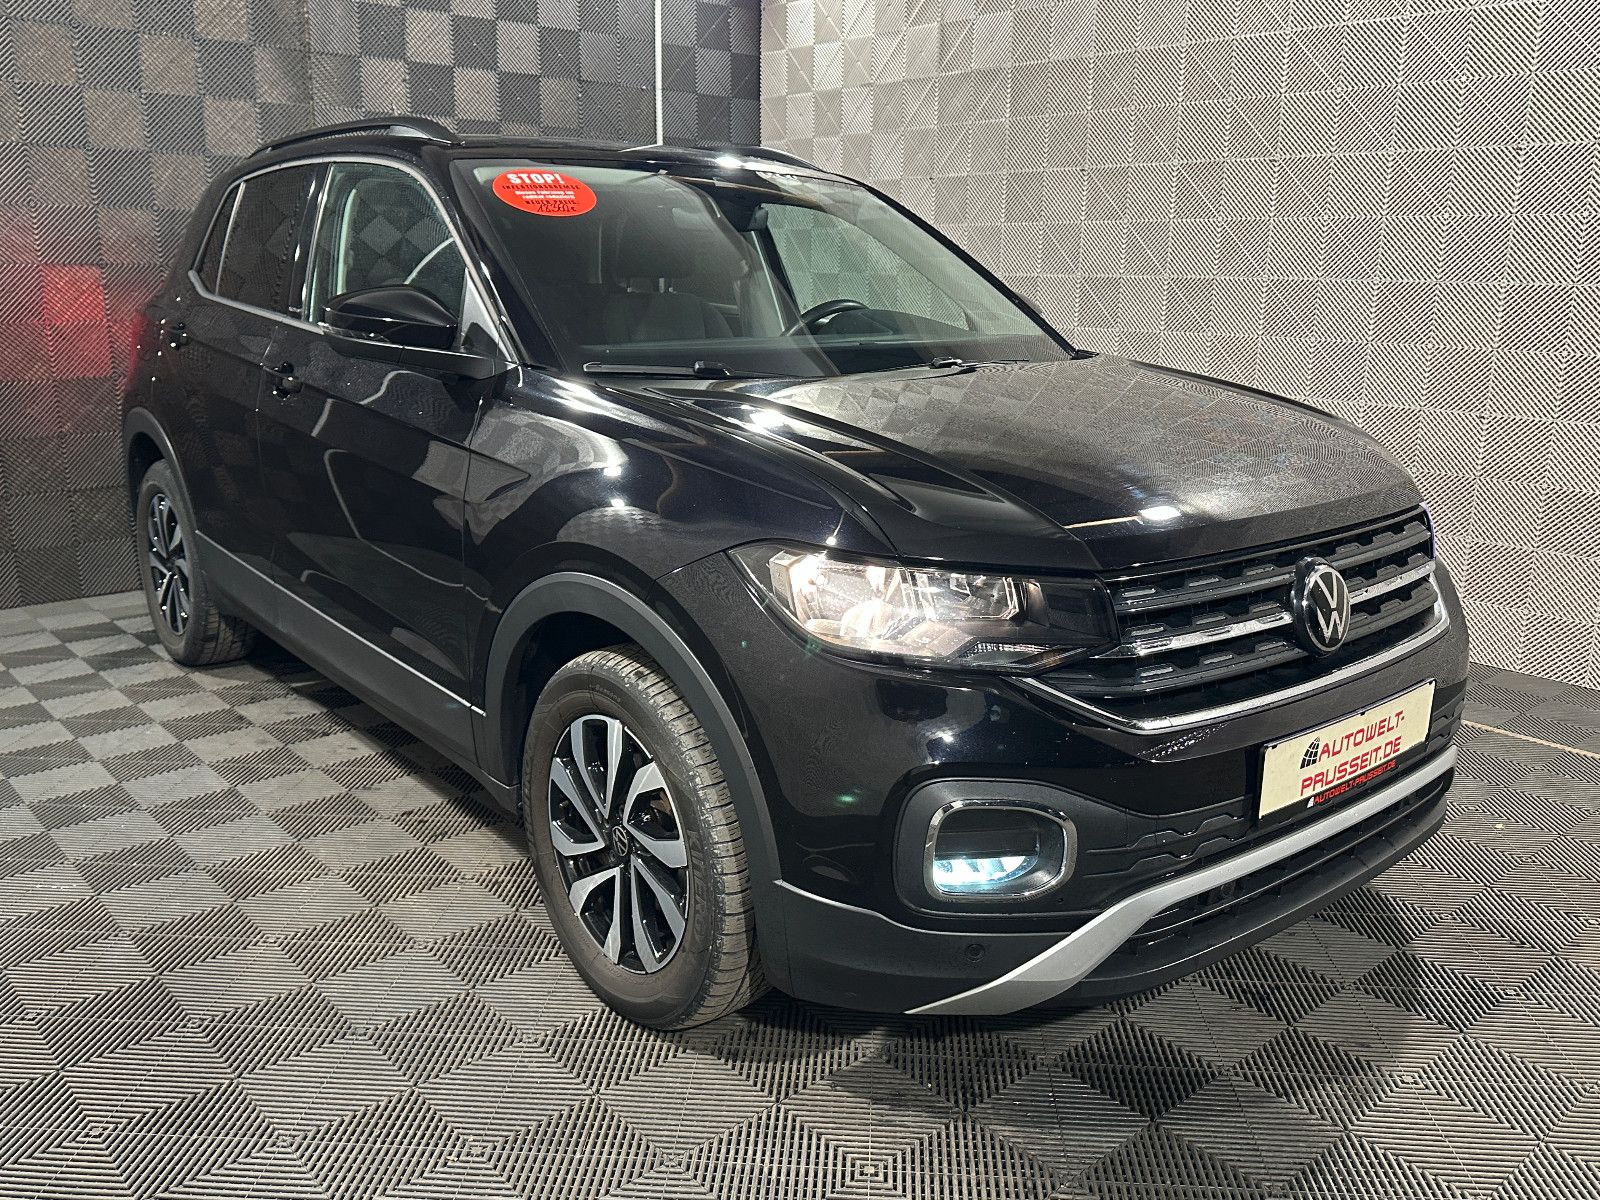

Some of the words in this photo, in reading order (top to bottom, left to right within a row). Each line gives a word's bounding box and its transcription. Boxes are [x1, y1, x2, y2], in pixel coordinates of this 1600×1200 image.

[507, 173, 565, 184] STOP!
[1317, 710, 1405, 763] AUTOWELT-
[1300, 735, 1402, 797] PRUSSEIT.DE
